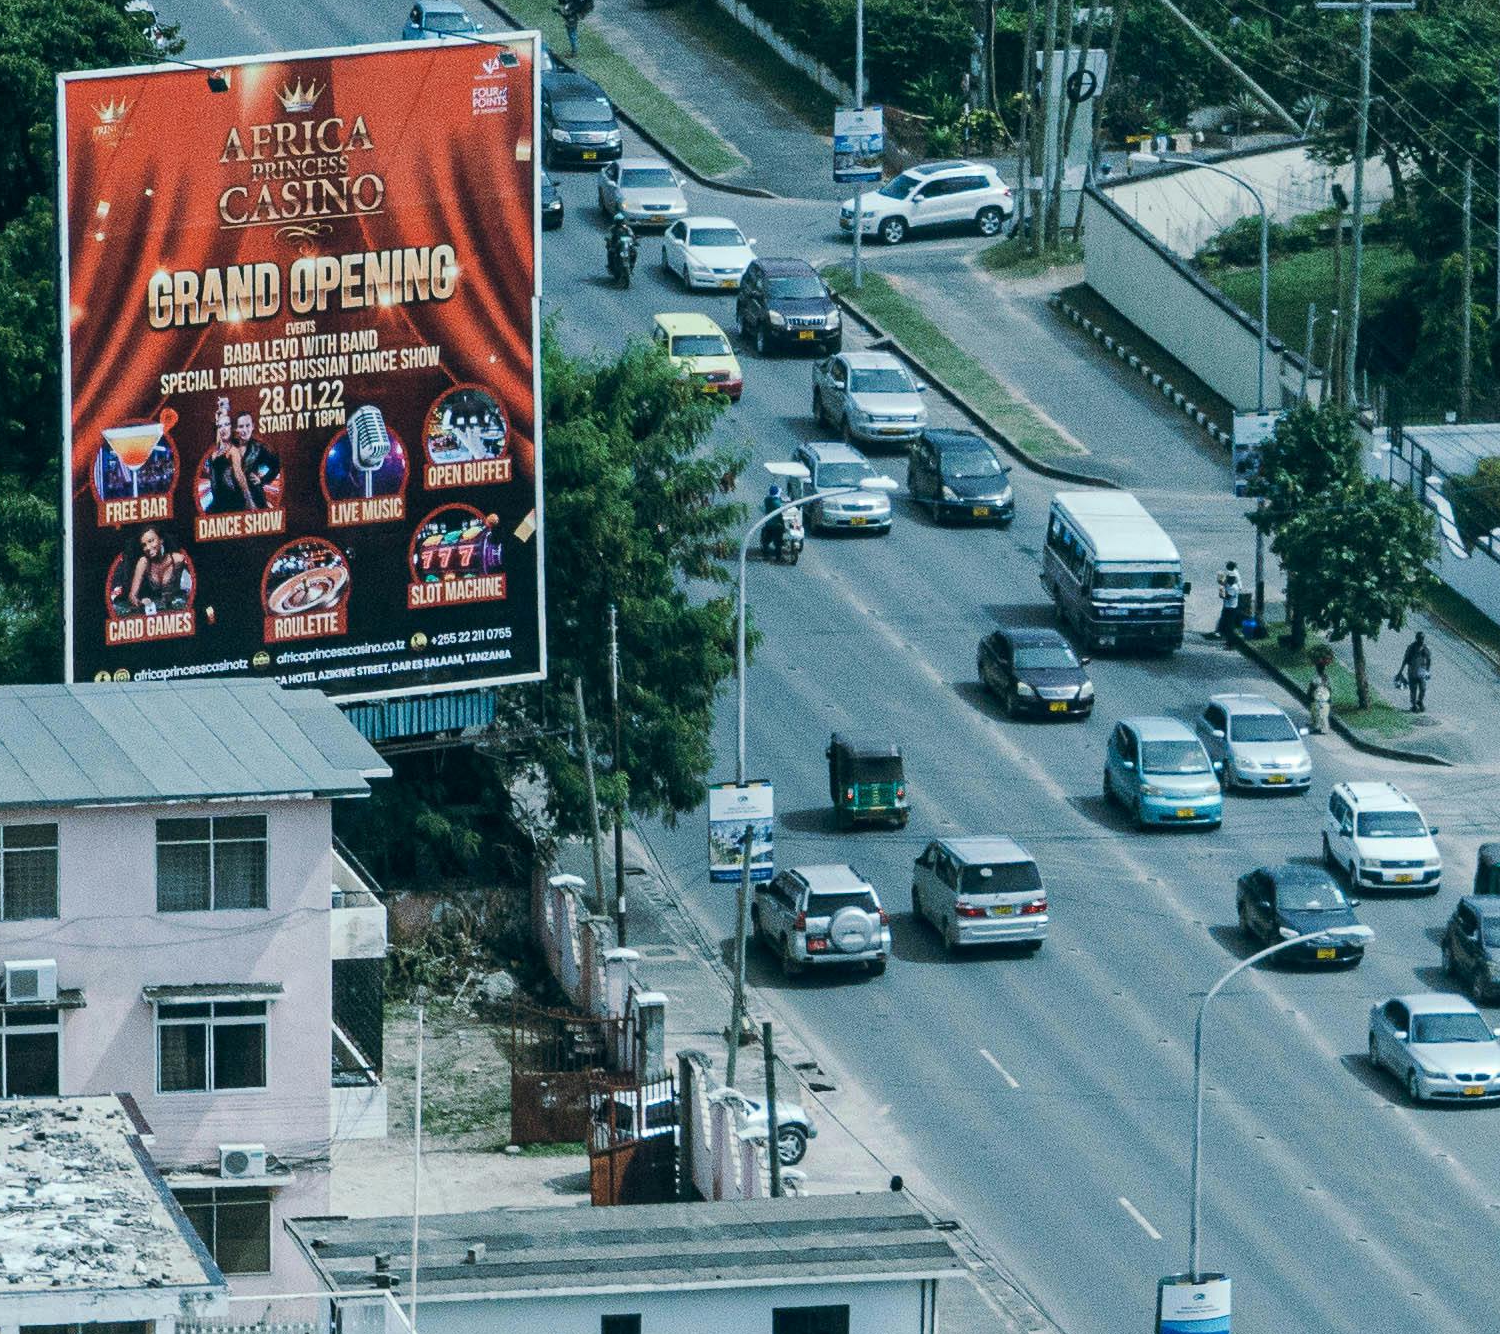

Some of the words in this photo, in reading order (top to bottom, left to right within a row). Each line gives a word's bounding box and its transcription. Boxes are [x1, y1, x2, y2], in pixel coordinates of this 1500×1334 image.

[473, 88, 499, 98] FOUR
[473, 97, 508, 108] POINTS
[219, 116, 373, 163] AFRICA
[251, 154, 349, 182] PRINCESS
[219, 173, 385, 224] CASINO
[148, 262, 280, 329] GRAND
[290, 244, 457, 314] OPENING
[285, 320, 316, 336] EVENTS
[223, 344, 262, 365] BABA
[265, 338, 299, 361] LEVO
[302, 334, 337, 357] WITH
[340, 329, 379, 352] BAND
[160, 372, 218, 395] SPECIAL
[220, 365, 287, 389] PRINCESS
[290, 358, 349, 381] RUSSIAN
[352, 352, 397, 374] DANCE
[400, 346, 441, 369] SHOW
[258, 379, 345, 416] 28.01.22
[258, 412, 293, 434] START
[296, 410, 311, 429] AT
[314, 408, 346, 428] 18PM
[427, 466, 462, 487] OPEN
[464, 459, 511, 483] BUFFET
[105, 500, 137, 523] FREE
[140, 498, 168, 519] BAR
[331, 501, 359, 525] LIVE
[361, 498, 402, 521] MUSIC
[198, 516, 241, 539] DANCE
[244, 511, 283, 534] SHOW
[411, 583, 442, 605] SLOT
[444, 577, 503, 602] MACHINE
[108, 619, 144, 642] CARD
[146, 612, 193, 638] GAMES
[274, 612, 340, 638] ROULETTE
[431, 633, 457, 646] +255
[458, 631, 471, 643] 22
[472, 629, 484, 641] 211
[276, 639, 406, 665] africaprincesscasino.co.tz
[134, 658, 249, 681] africaprincesscasinotz
[288, 671, 317, 684] HOTEL
[391, 661, 411, 672] DAR
[412, 659, 423, 669] ES
[465, 649, 512, 663] TANZANIA
